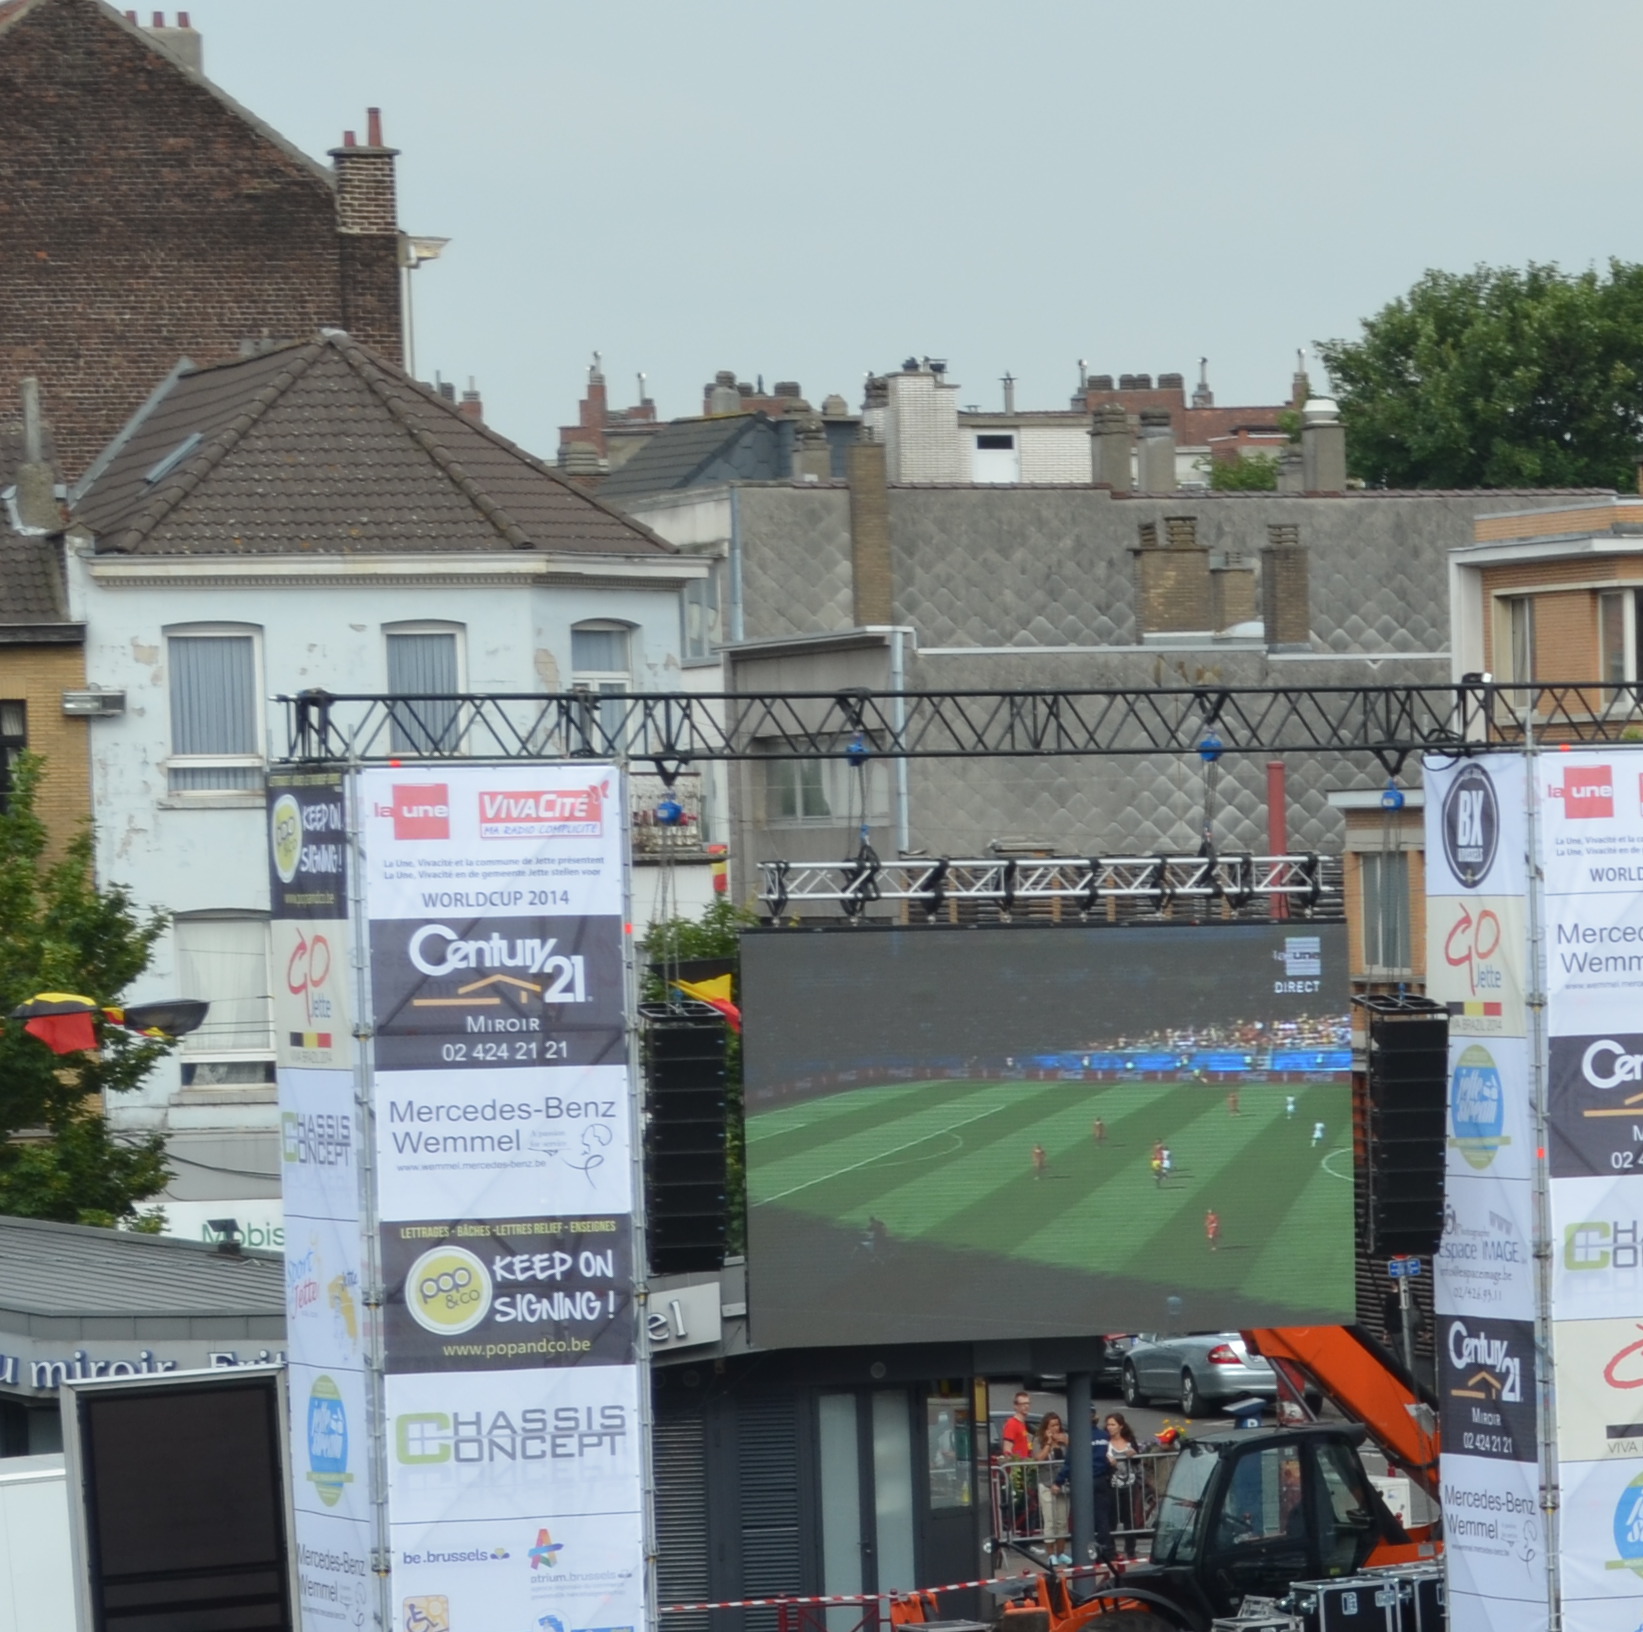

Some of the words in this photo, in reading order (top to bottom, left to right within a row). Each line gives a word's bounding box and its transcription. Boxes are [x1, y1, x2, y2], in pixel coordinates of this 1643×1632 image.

[1572, 785, 1612, 798] une
[403, 805, 448, 817] une
[1457, 790, 1484, 847] BX
[422, 891, 524, 908] WORLDCUP
[528, 890, 570, 906] 2014
[543, 955, 587, 1003] 21
[1274, 980, 1320, 995] DIRECT
[442, 1045, 468, 1062] 02
[473, 1043, 510, 1061] 424
[514, 1042, 538, 1060] 21
[544, 1041, 568, 1059] 21
[389, 1096, 616, 1123] Mercedes-Benz
[393, 1129, 521, 1154] Wemmel
[1611, 1153, 1633, 1168] 02
[401, 1224, 450, 1239] LETTRAGES
[534, 1221, 562, 1234] RELIEF
[570, 1220, 616, 1233] ENSEIGNES
[1482, 1241, 1519, 1262] IMAGE
[492, 1252, 572, 1281] KEEP
[579, 1249, 614, 1280] ON
[495, 1292, 602, 1322] SIGNING
[442, 1338, 591, 1358] www.popandco.be
[1502, 1357, 1520, 1402] 21
[1464, 1432, 1474, 1447] 02
[1475, 1434, 1491, 1450] 424
[1492, 1435, 1501, 1452] 21
[1503, 1437, 1512, 1453] 21
[1608, 1439, 1637, 1454] VIVA
[1445, 1484, 1535, 1516] Mercedes-Benz
[1446, 1517, 1498, 1540] Wemmel
